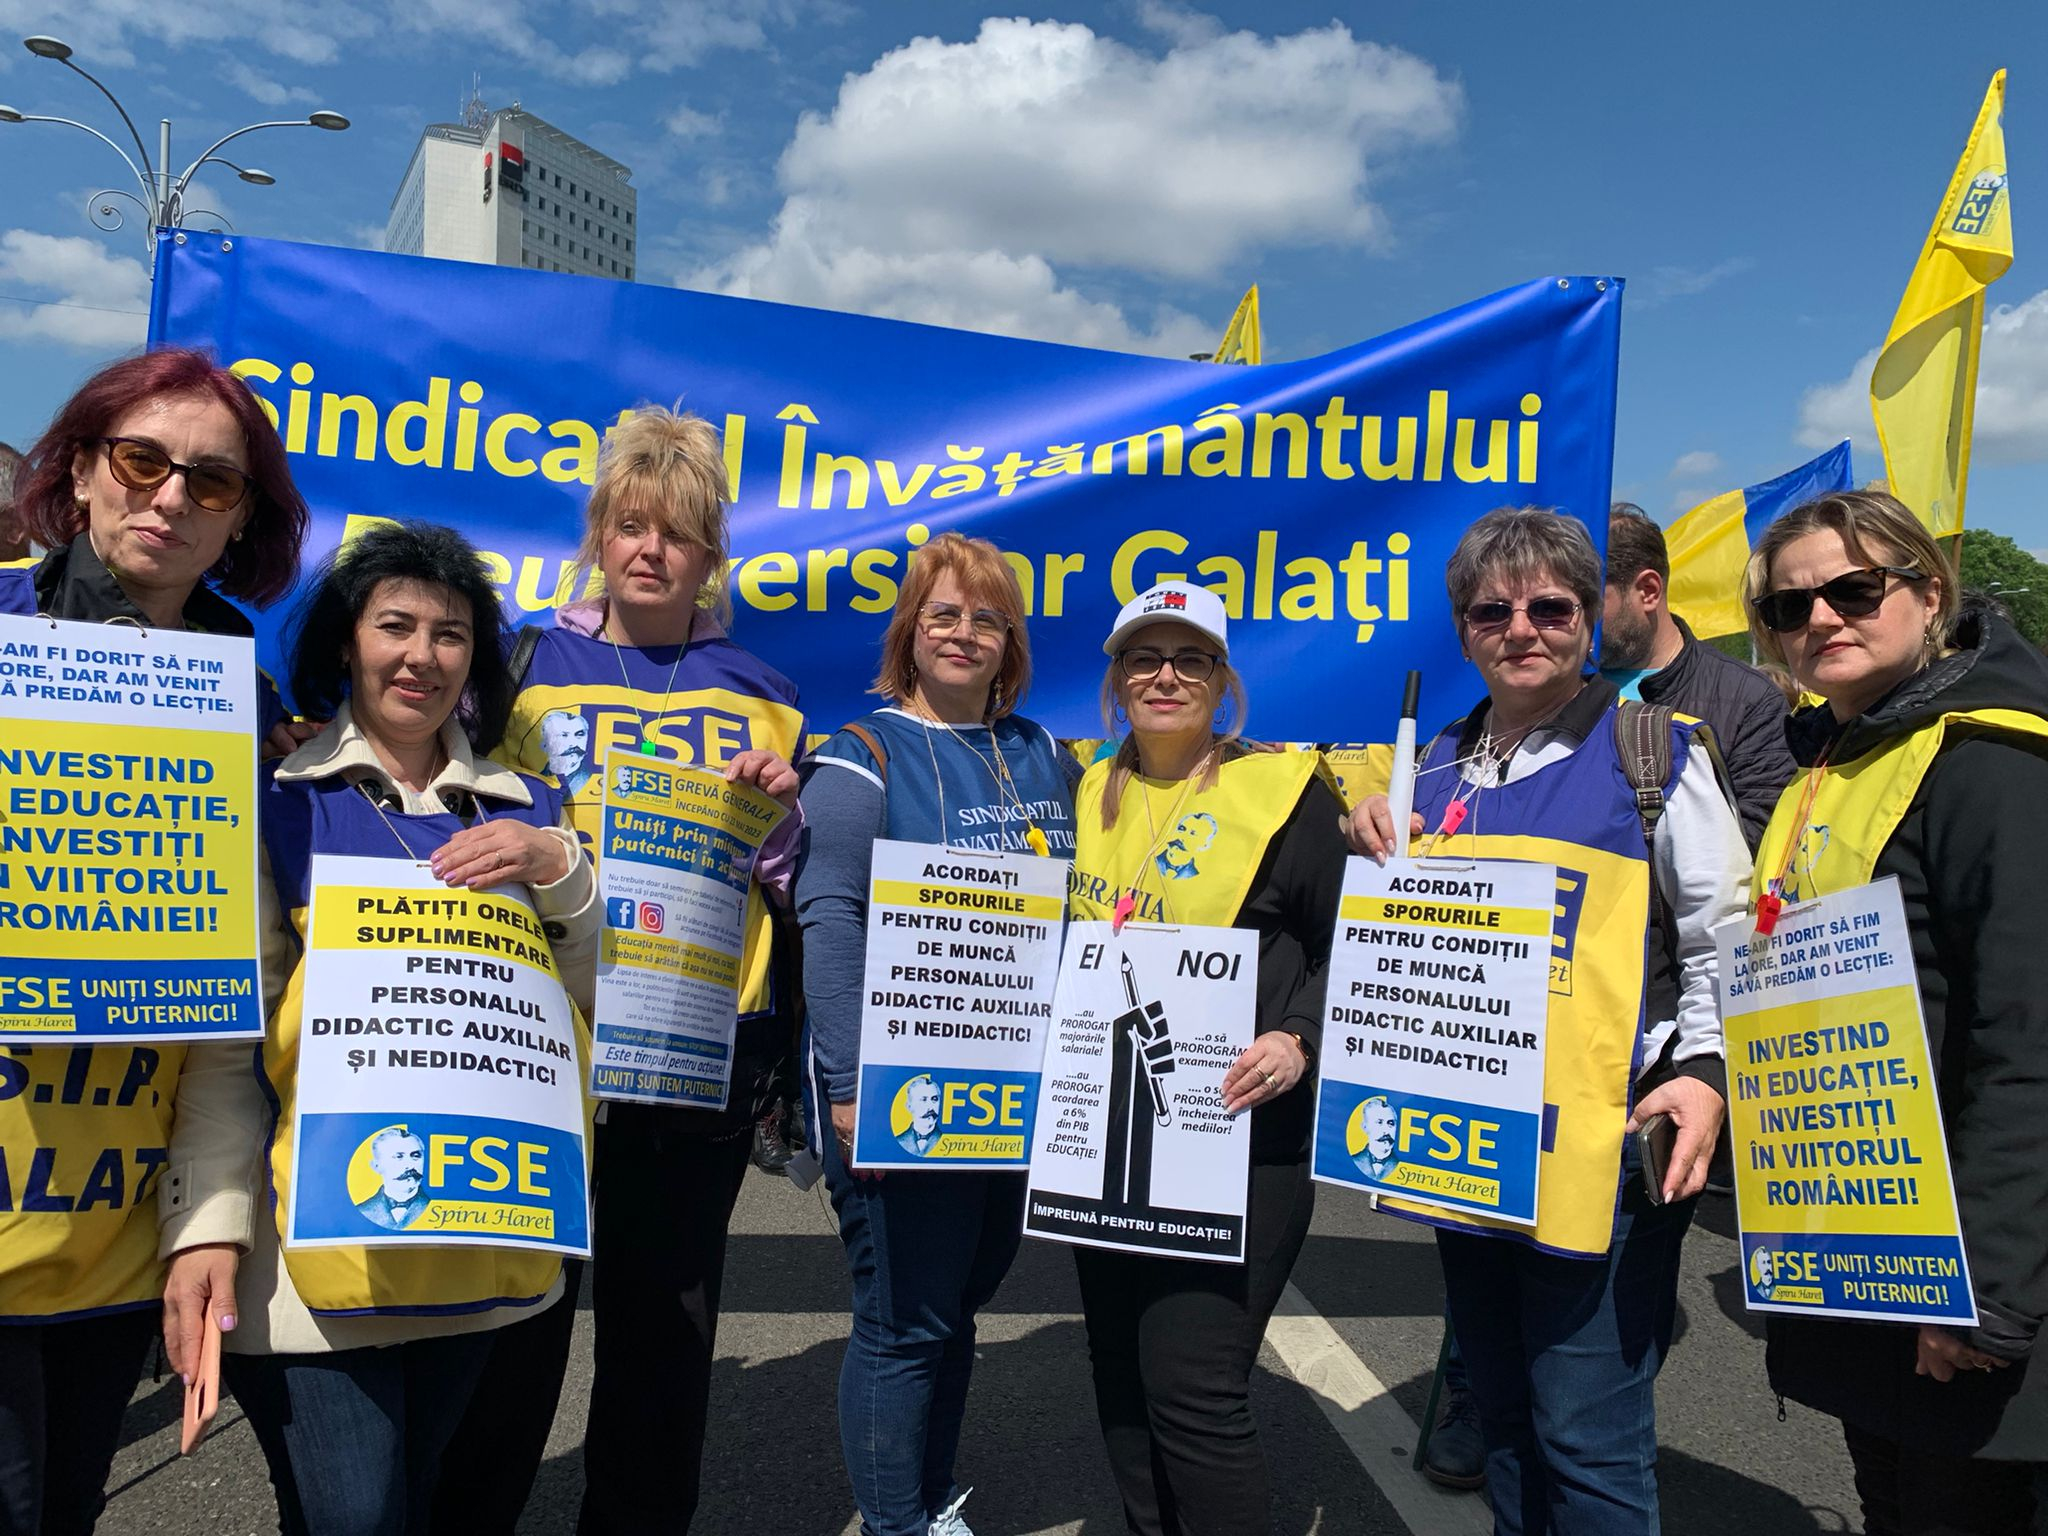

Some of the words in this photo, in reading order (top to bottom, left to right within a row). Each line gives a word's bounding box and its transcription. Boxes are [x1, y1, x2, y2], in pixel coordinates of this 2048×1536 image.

[228, 358, 746, 503] Sindical
[776, 390, 1542, 510] Învățământului
[1110, 530, 1411, 643] Galați
[47, 647, 67, 660] FI
[76, 649, 145, 667] DORIT
[152, 654, 181, 671] SĂ
[187, 659, 223, 674] FIM
[62, 667, 109, 683] DAR
[115, 671, 149, 687] AM
[156, 675, 220, 693] VENIT
[25, 684, 122, 704] PREDĂM
[130, 692, 146, 706] O
[153, 694, 234, 714] LECȚIE:
[594, 712, 743, 766] FSE
[0, 749, 214, 784] NVESTIND
[10, 787, 240, 829] EDUCAȚIE,
[631, 770, 671, 794] FSE
[675, 778, 719, 800] GREVĂ
[722, 789, 776, 823] GENERALĂ
[675, 798, 720, 820] ÎNCEPÂND
[958, 800, 1068, 826] SINDICATUL
[2, 826, 204, 866] NVESTIȚI
[612, 835, 697, 862] puternici
[673, 824, 707, 846] prin
[25, 865, 228, 895] VIITORUL
[922, 863, 1018, 890] ACORDAȚI
[1388, 877, 1493, 903] ACORDAȚI
[919, 888, 1025, 912] SPORURILE
[0, 900, 218, 932] ROMÂNIEI!
[357, 896, 468, 921] PLĂTIȚI
[477, 899, 544, 941] ORELE
[882, 911, 962, 932] PENTRU
[968, 919, 1047, 944] CONDIȚII
[1383, 903, 1500, 928] SPORURILE
[1345, 926, 1425, 948] PENTRU
[1431, 934, 1529, 962] CONDIȚII
[1734, 939, 1769, 959] NE-AM
[1771, 936, 1782, 950] FI
[1785, 924, 1825, 946] DORIT
[1830, 916, 1850, 935] SĂ
[1853, 911, 1880, 931] FIM
[357, 926, 551, 972] SUPLIMENTARE
[610, 949, 642, 961] trebuie
[917, 941, 942, 957] DE
[949, 943, 1016, 963] MUNCĂ
[1079, 944, 1105, 970] EI
[1176, 949, 1242, 981] NOI
[1734, 965, 1749, 978] LA
[1751, 956, 1778, 973] ORE,
[1781, 949, 1806, 967] DAR
[1809, 943, 1831, 961] AM
[1834, 933, 1880, 954] VENIT
[406, 957, 514, 984] PENTRU
[890, 965, 1034, 990] PERSONALULUI
[1377, 957, 1403, 975] DE
[1409, 960, 1486, 984] MUNCĂ
[1729, 979, 1746, 998] SĂ
[1747, 974, 1763, 993] VĂ
[1764, 963, 1816, 991] PREDĂM
[1820, 963, 1831, 978] O
[1836, 952, 1894, 974] LECȚIE:
[0, 976, 73, 1008] FSE
[81, 980, 147, 1002] UNIȚI
[154, 978, 251, 997] SUNTEM
[1350, 981, 1511, 1017] PERSONALULUI
[107, 1003, 238, 1025] PUTERNICI!
[371, 986, 546, 1023] PERSONALUL
[871, 991, 965, 1011] DIDACTIC
[970, 998, 1052, 1018] AUXILIAR
[33, 1016, 73, 1028] Haret
[887, 1019, 907, 1040] ȘI
[914, 1021, 1031, 1042] NEDIDACTIC!
[1060, 1019, 1111, 1032] PROROGAT
[1331, 1006, 1424, 1034] DIDACTIC
[1430, 1020, 1538, 1050] AUXILIAR
[312, 1017, 454, 1037] DIDACTIC
[463, 1021, 572, 1062] AUXILIAR
[1059, 1031, 1106, 1045] majorările
[1061, 1044, 1104, 1057] salariale!
[1214, 1033, 1227, 1042] să
[1748, 1021, 1890, 1065] INVESTIND
[347, 1049, 376, 1074] ȘI
[388, 1049, 557, 1087] NEDIDACTIC!
[606, 1046, 631, 1062] Este
[634, 1050, 669, 1067] timpul
[1345, 1036, 1364, 1057] ȘI
[1371, 1039, 1508, 1076] NEDIDACTIC!
[597, 1069, 634, 1090] UNIȚI
[637, 1074, 682, 1093] SUNTEM
[1051, 1080, 1104, 1095] PROROGAT
[1737, 1071, 1766, 1101] ÎN
[1768, 1057, 1919, 1097] EDUCAȚIE,
[941, 1082, 1025, 1127] FSE
[1051, 1095, 1100, 1107] acordarea
[1070, 1108, 1087, 1119] 6%
[1173, 1093, 1226, 1108] PROROG
[1056, 1119, 1072, 1129] din
[1073, 1121, 1089, 1132] PIB
[1178, 1107, 1236, 1122] încheierea
[1760, 1098, 1896, 1136] INVESTIȚI
[1054, 1134, 1088, 1145] pentru
[1181, 1122, 1232, 1135] mediilor!
[1398, 1107, 1500, 1170] FSE
[939, 1138, 978, 1156] Spiru
[980, 1139, 1022, 1153] Haret
[1046, 1143, 1098, 1160] EDUCAȚIE!
[1750, 1140, 1776, 1171] ÎN
[1782, 1138, 1922, 1169] VIITORUL
[428, 1133, 551, 1197] FSE
[1396, 1166, 1441, 1188] Spiru
[1443, 1176, 1497, 1199] Haret
[1767, 1173, 1919, 1206] ROMÂNIEI!
[427, 1205, 487, 1229] Spiru
[491, 1207, 552, 1231] Haret
[1033, 1202, 1098, 1225] ÎMPREUNĂ
[1101, 1215, 1154, 1232] PENTRU
[1158, 1223, 1232, 1242] EDUCAȚIE!
[1772, 1251, 1821, 1282] FSE
[1823, 1254, 1870, 1278] UNIȚI
[1875, 1255, 1959, 1278] SUNTEM
[1776, 1286, 1797, 1300] Spiru
[1798, 1287, 1823, 1300] Haret
[1843, 1281, 1949, 1306] PUTERNICI!
